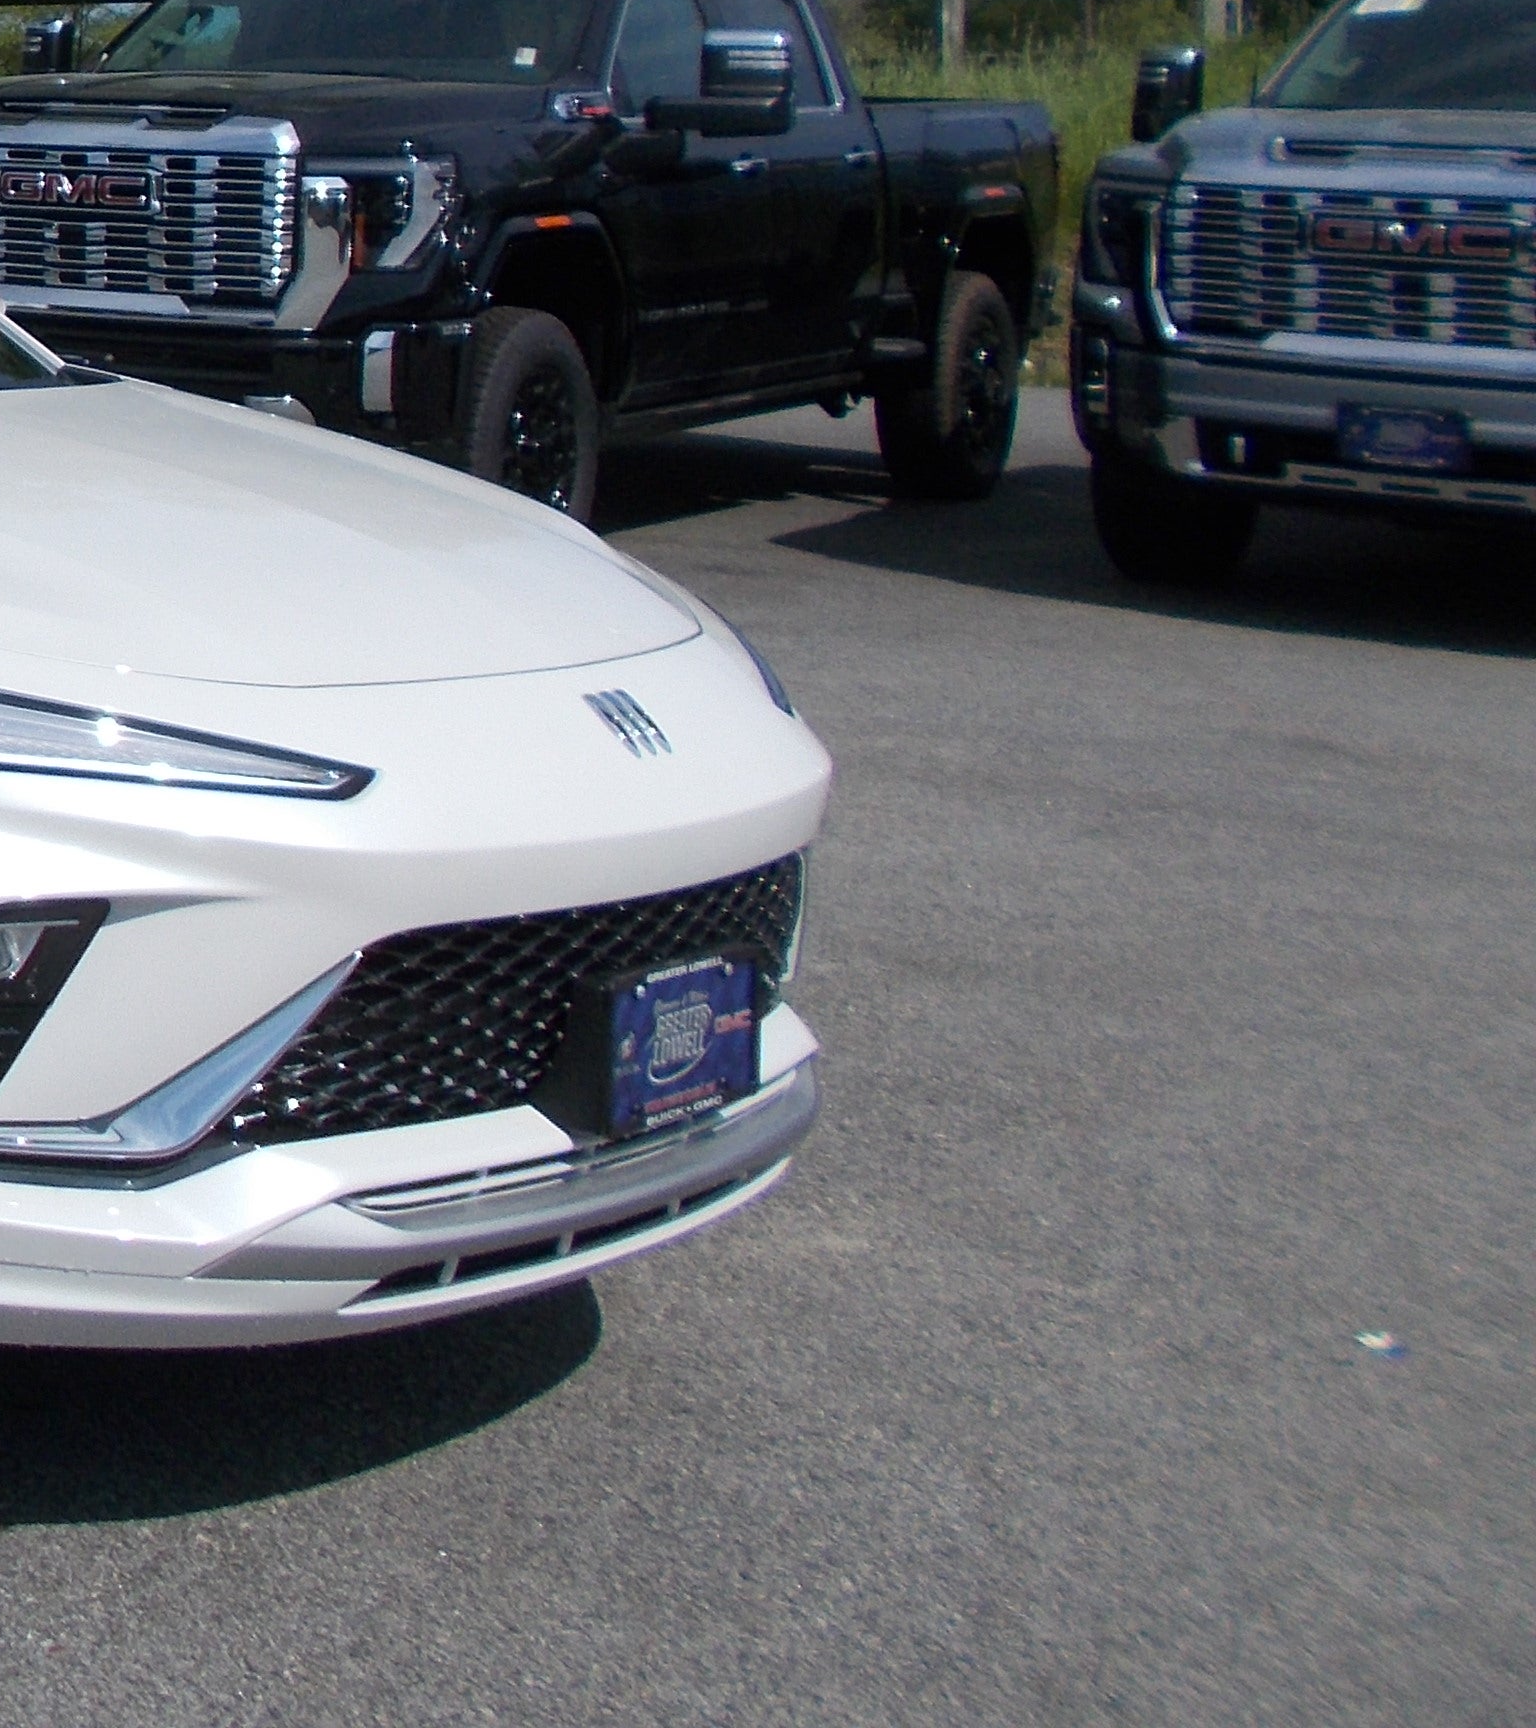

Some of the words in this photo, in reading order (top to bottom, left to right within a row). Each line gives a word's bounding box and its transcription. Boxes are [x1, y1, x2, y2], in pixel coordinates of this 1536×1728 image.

[1, 171, 147, 205] GMC
[1317, 220, 1510, 257] GMC
[646, 1108, 684, 1129] BUICK
[693, 1095, 724, 1112] GMC
